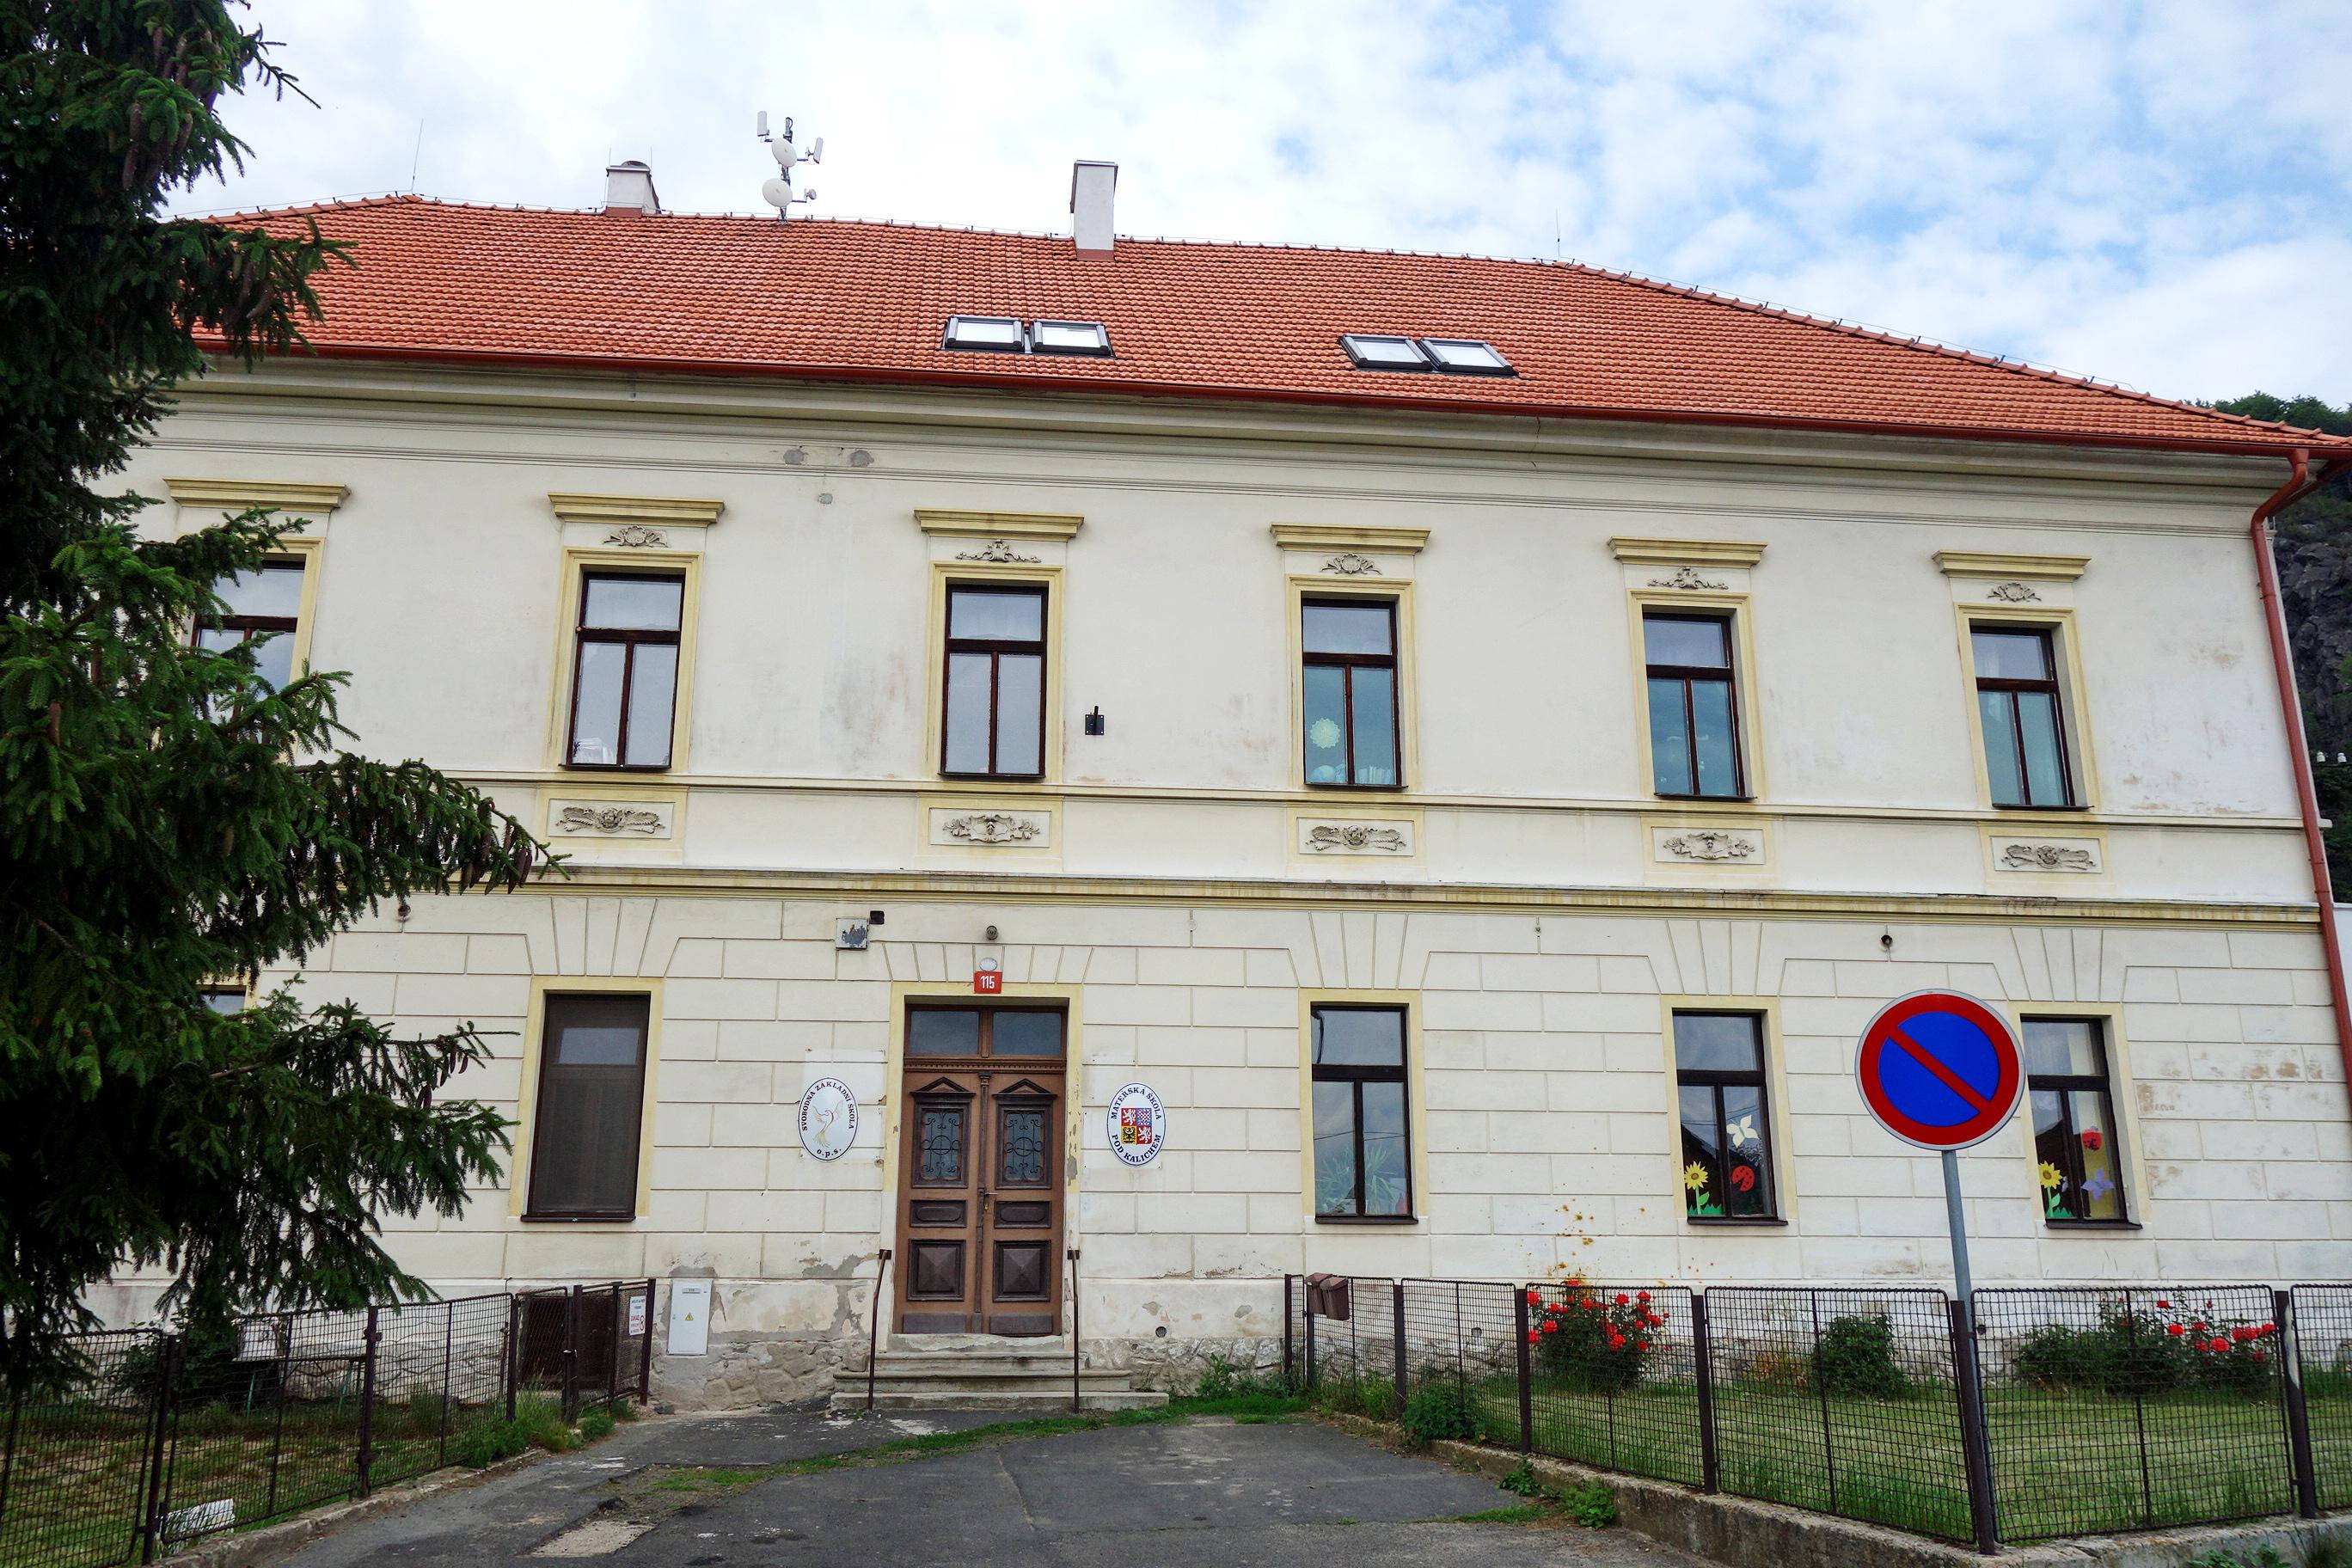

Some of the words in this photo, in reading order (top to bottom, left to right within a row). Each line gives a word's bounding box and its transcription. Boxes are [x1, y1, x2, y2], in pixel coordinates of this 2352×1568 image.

[980, 976, 995, 989] 115
[1111, 1087, 1146, 1119] MATEŘSKÁ
[1146, 1092, 1161, 1119] ŠKOLA
[817, 1148, 842, 1158] o.p.s.
[1112, 1134, 1124, 1153] POD
[1124, 1134, 1161, 1162] KALICHEM
